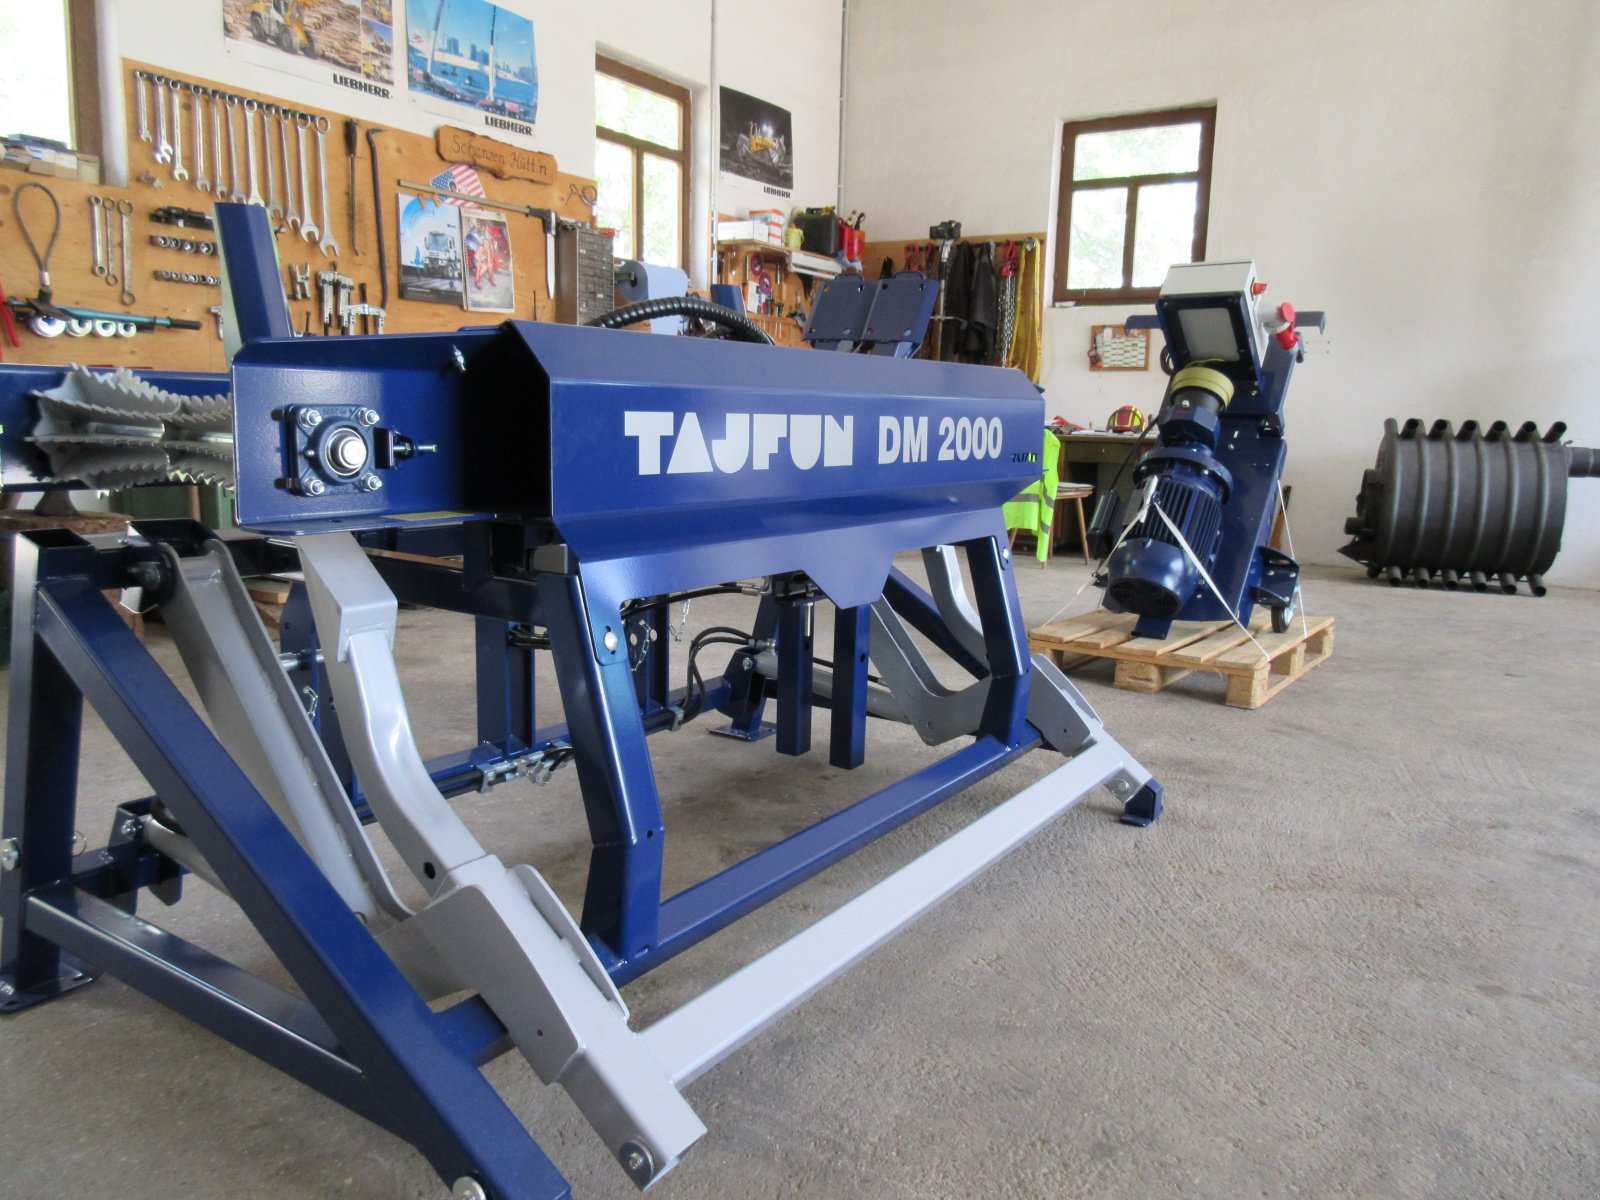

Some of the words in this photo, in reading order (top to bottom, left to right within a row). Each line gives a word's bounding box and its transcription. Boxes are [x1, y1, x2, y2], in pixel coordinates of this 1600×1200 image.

[333, 73, 390, 99] LIEBHERR
[484, 115, 533, 135] LIEBHERR
[624, 411, 854, 476] TAJFUN
[878, 415, 929, 465] DM
[937, 415, 1003, 462] 2000
